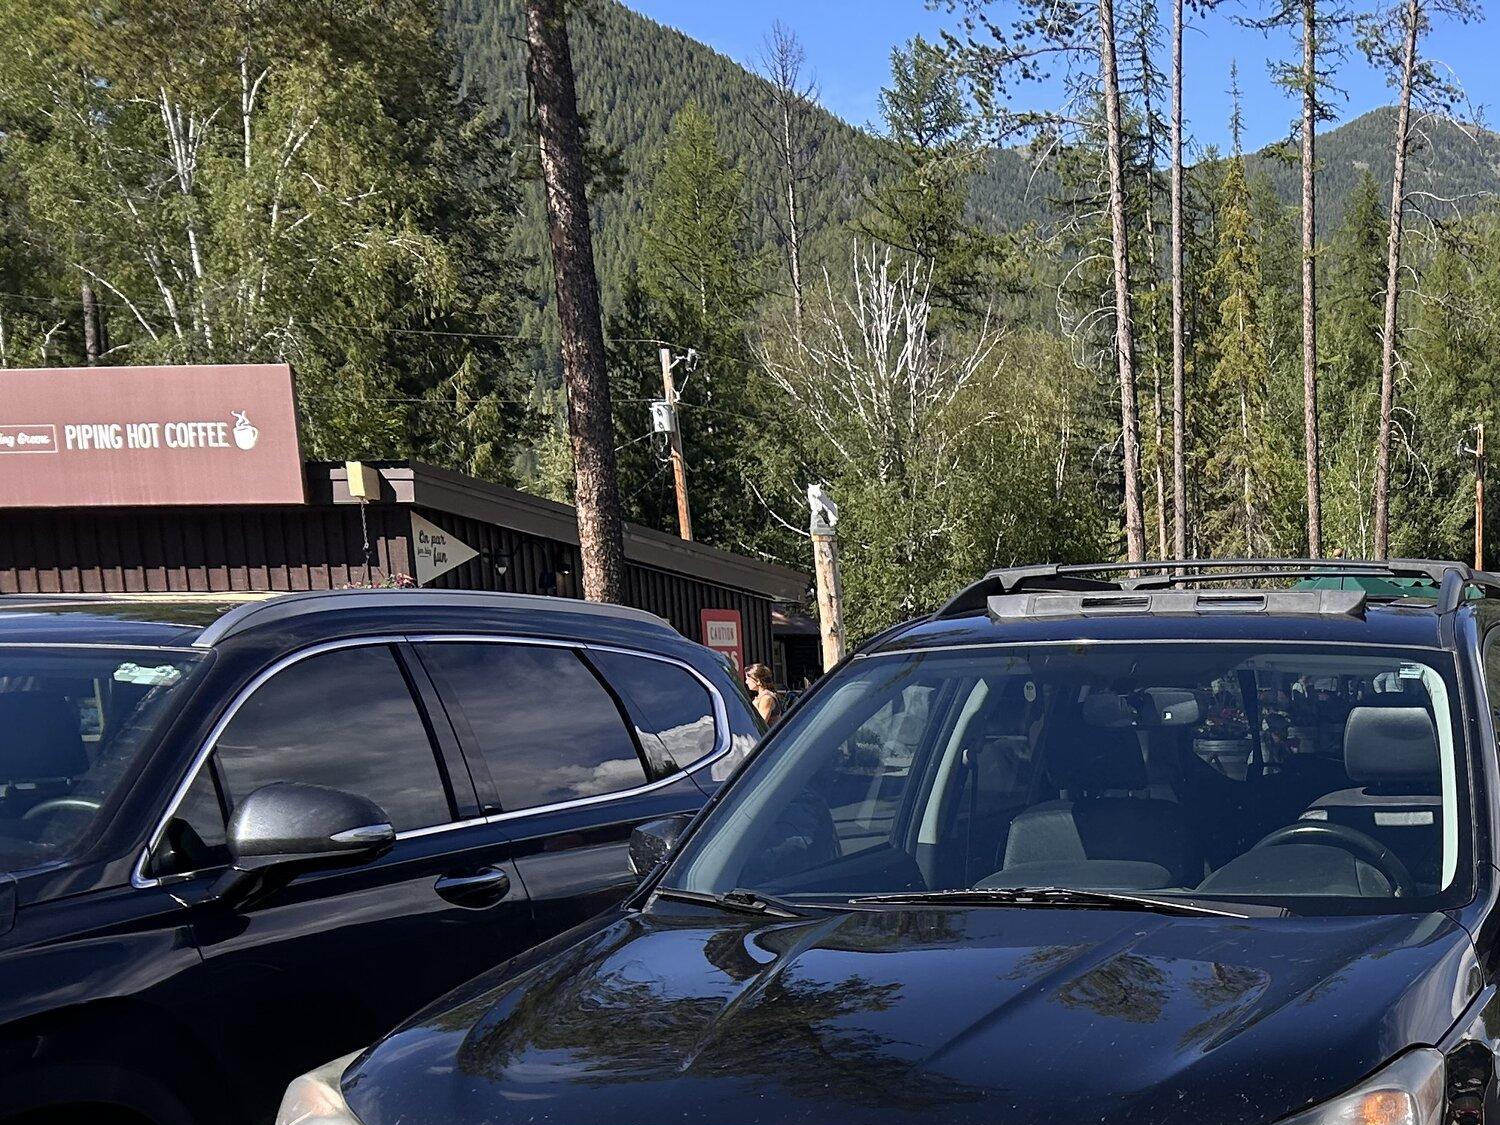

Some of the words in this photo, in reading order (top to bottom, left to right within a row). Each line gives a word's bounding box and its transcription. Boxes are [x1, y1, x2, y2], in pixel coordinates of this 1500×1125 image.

[64, 424, 123, 450] PIPING
[126, 423, 160, 449] HOT
[164, 422, 230, 448] COFFEE
[710, 626, 734, 640] CAUTION
